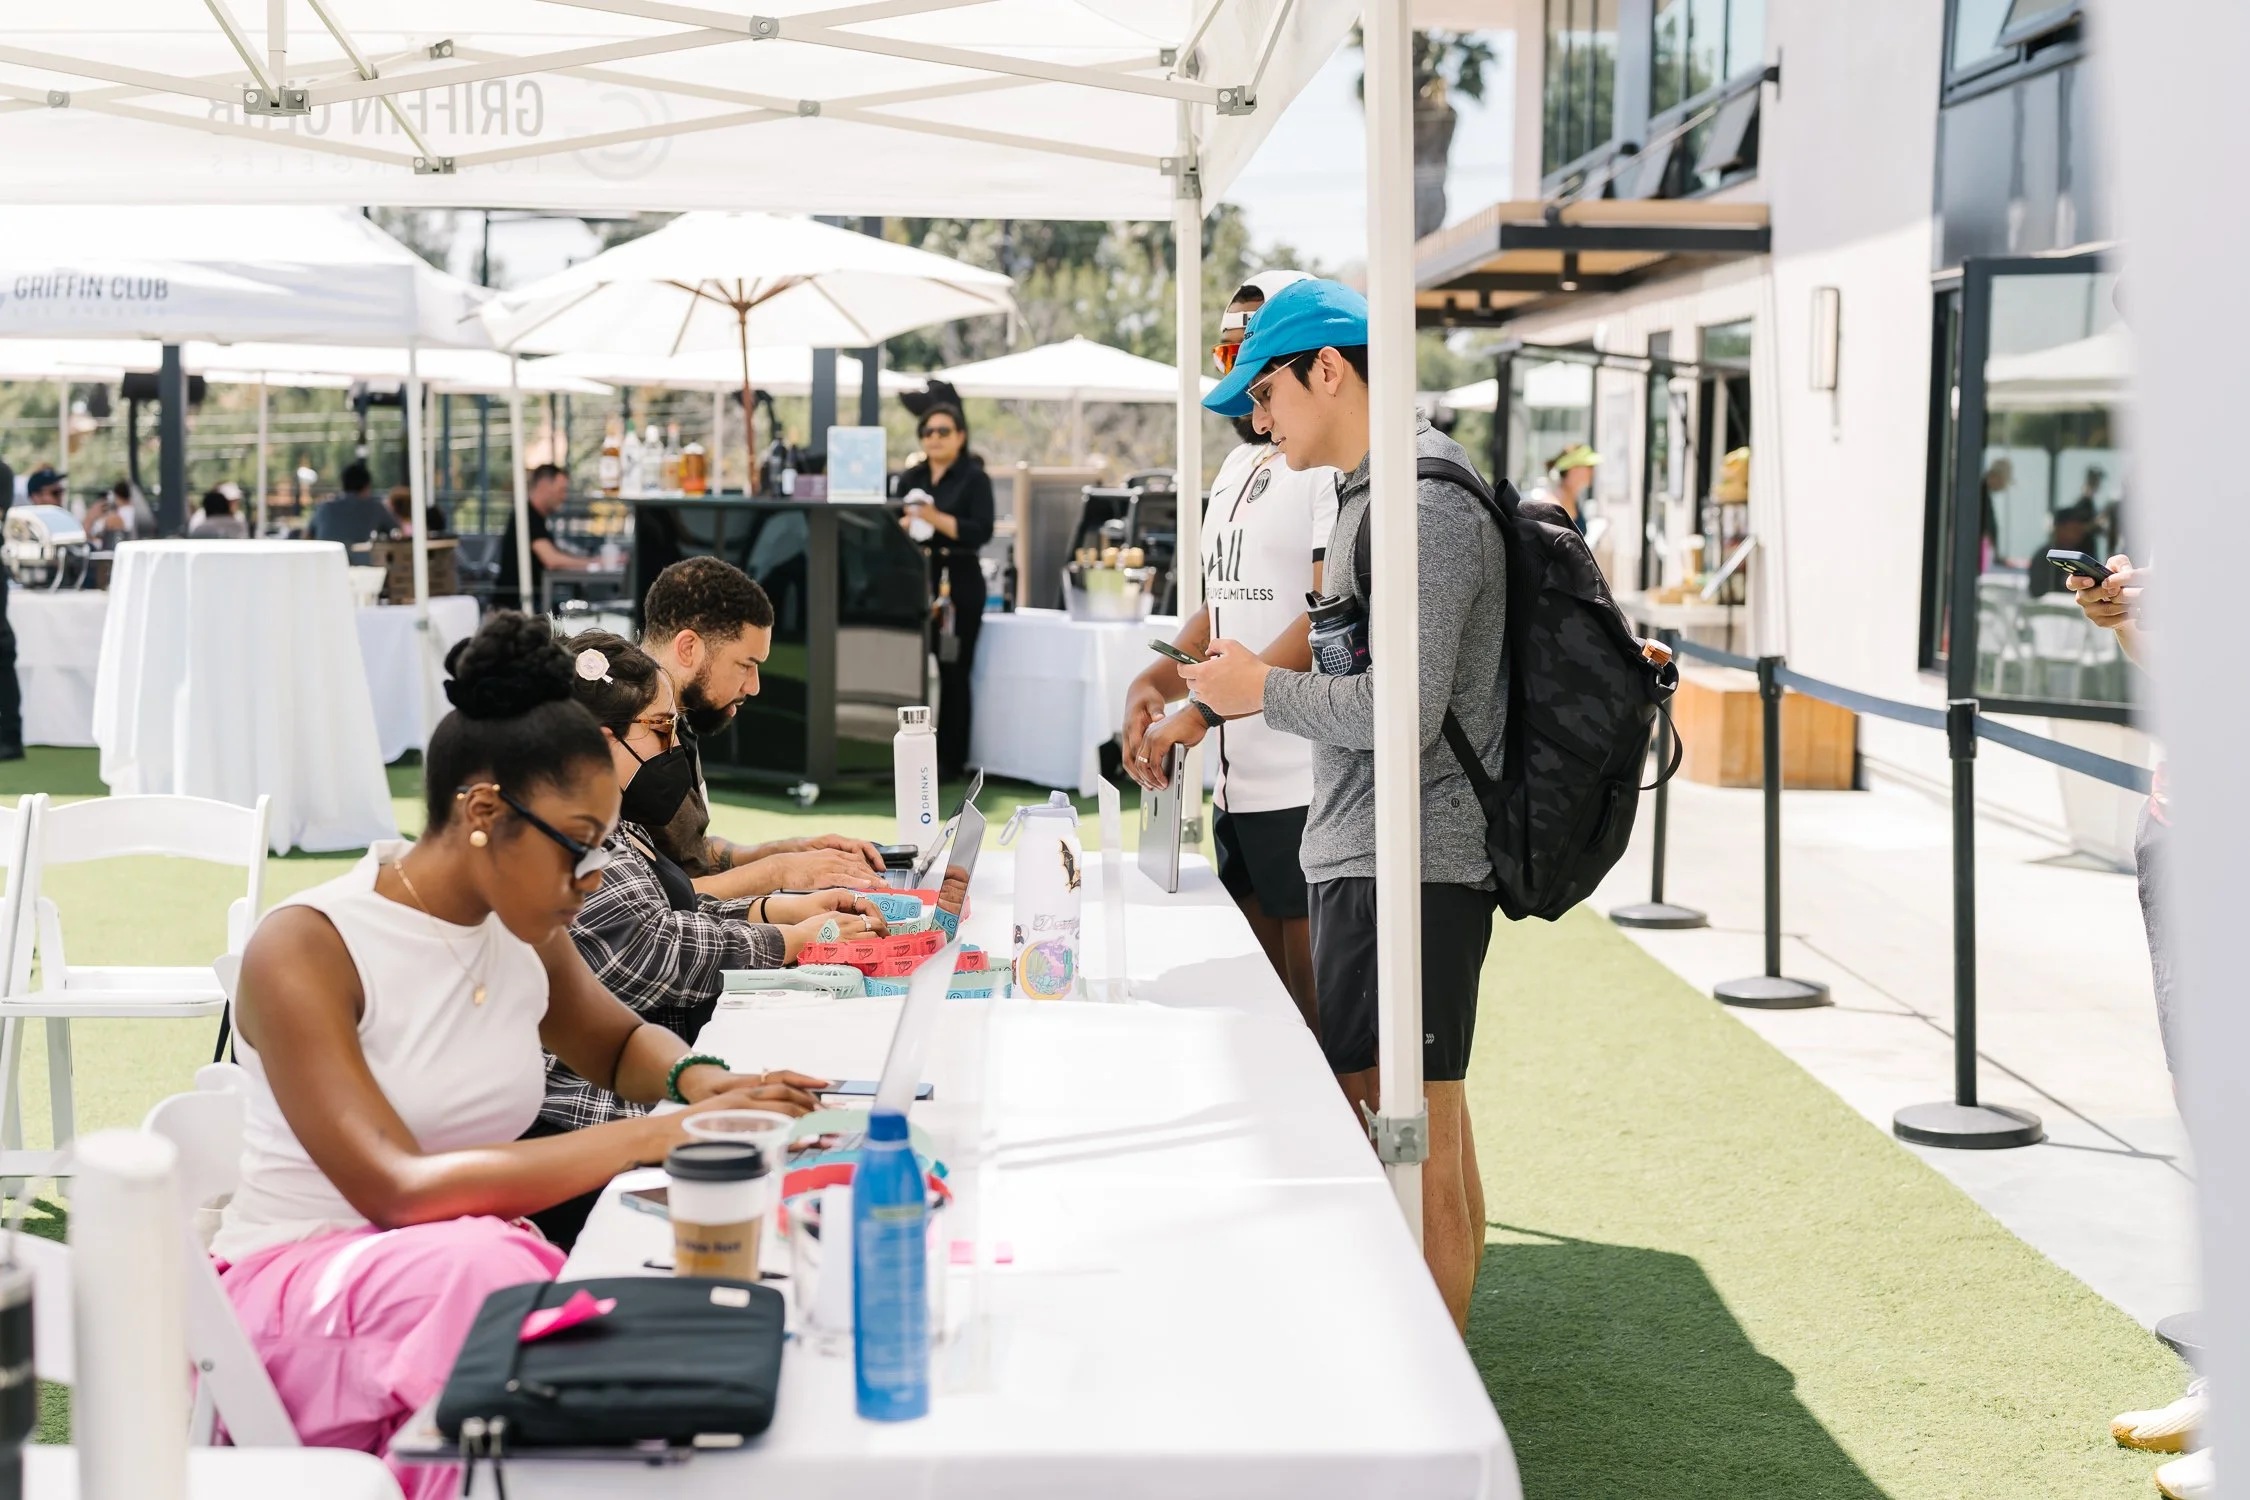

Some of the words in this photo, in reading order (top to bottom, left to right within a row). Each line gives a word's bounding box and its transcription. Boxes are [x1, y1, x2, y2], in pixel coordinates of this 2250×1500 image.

[14, 275, 103, 300] GRIFFIN
[111, 276, 169, 300] CLUB
[1223, 587, 1274, 601] LIMITLESS
[920, 766, 930, 809] DRINKS
